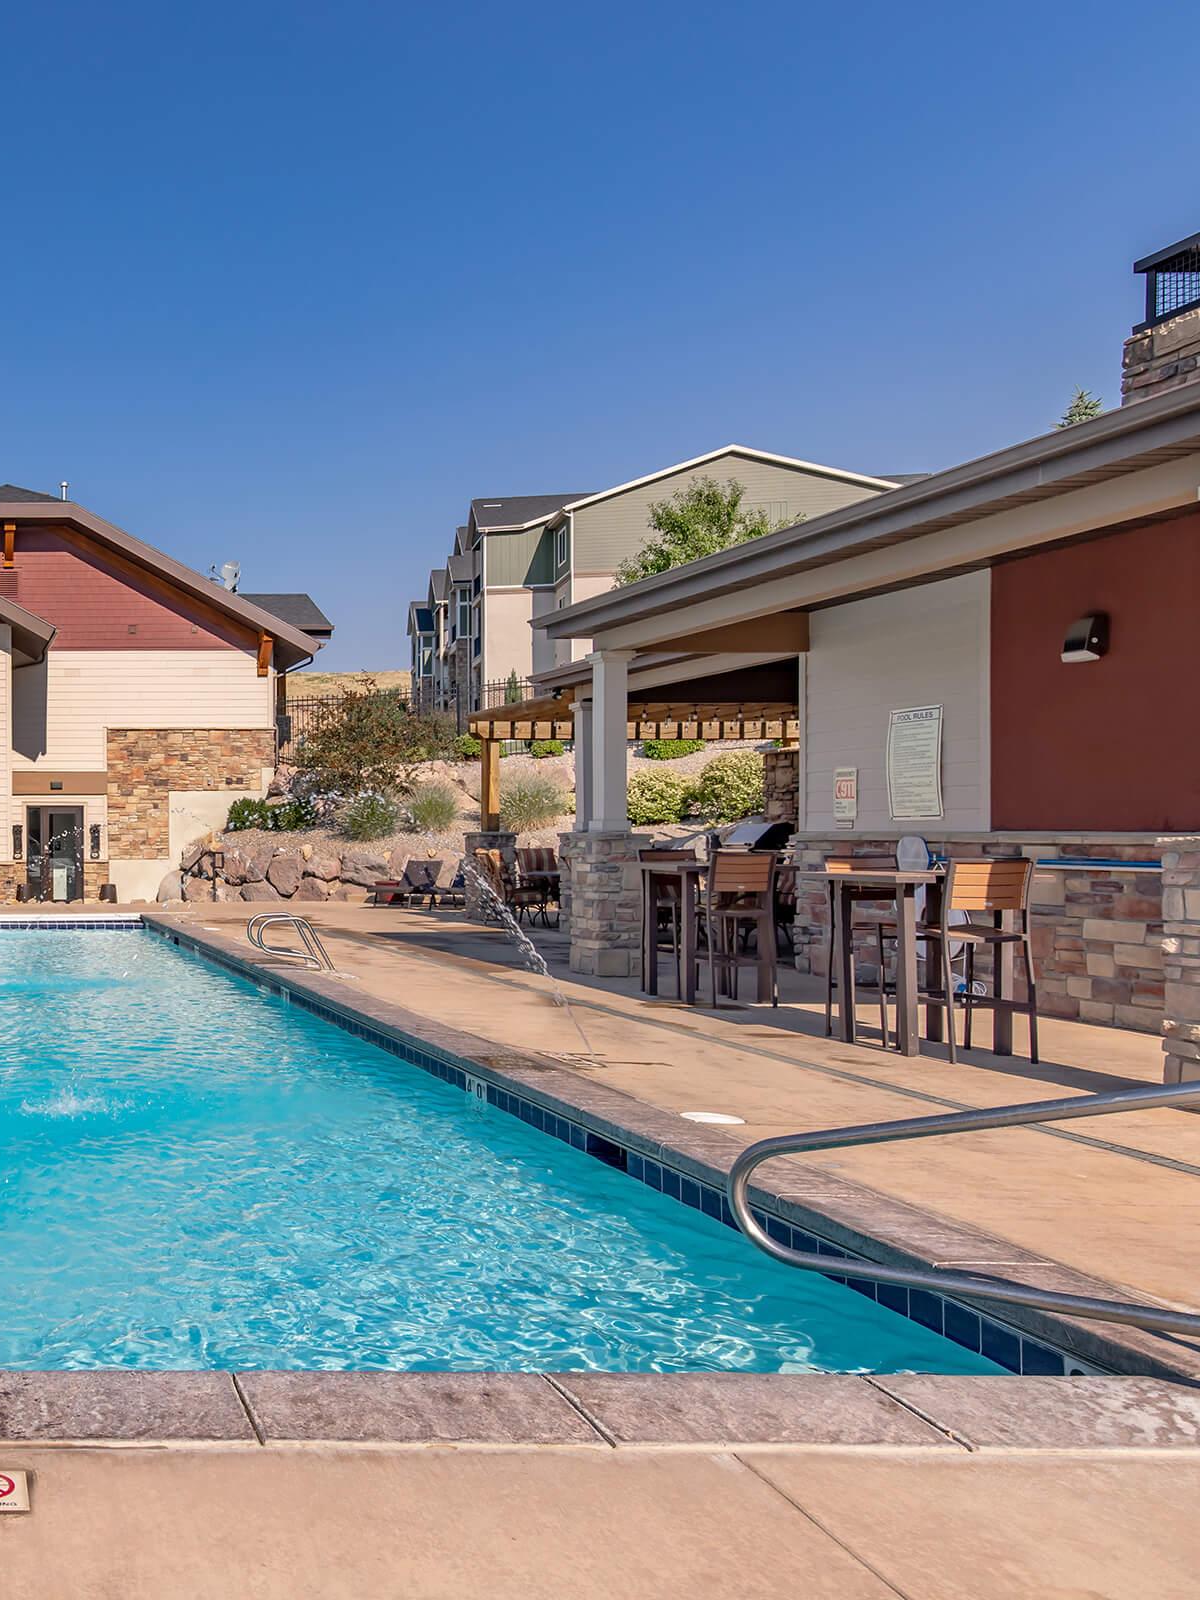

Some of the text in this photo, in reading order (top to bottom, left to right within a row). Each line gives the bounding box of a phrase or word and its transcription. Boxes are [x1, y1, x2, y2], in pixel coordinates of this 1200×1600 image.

[896, 711, 934, 721] POOL RULES
[840, 781, 855, 798] 911
